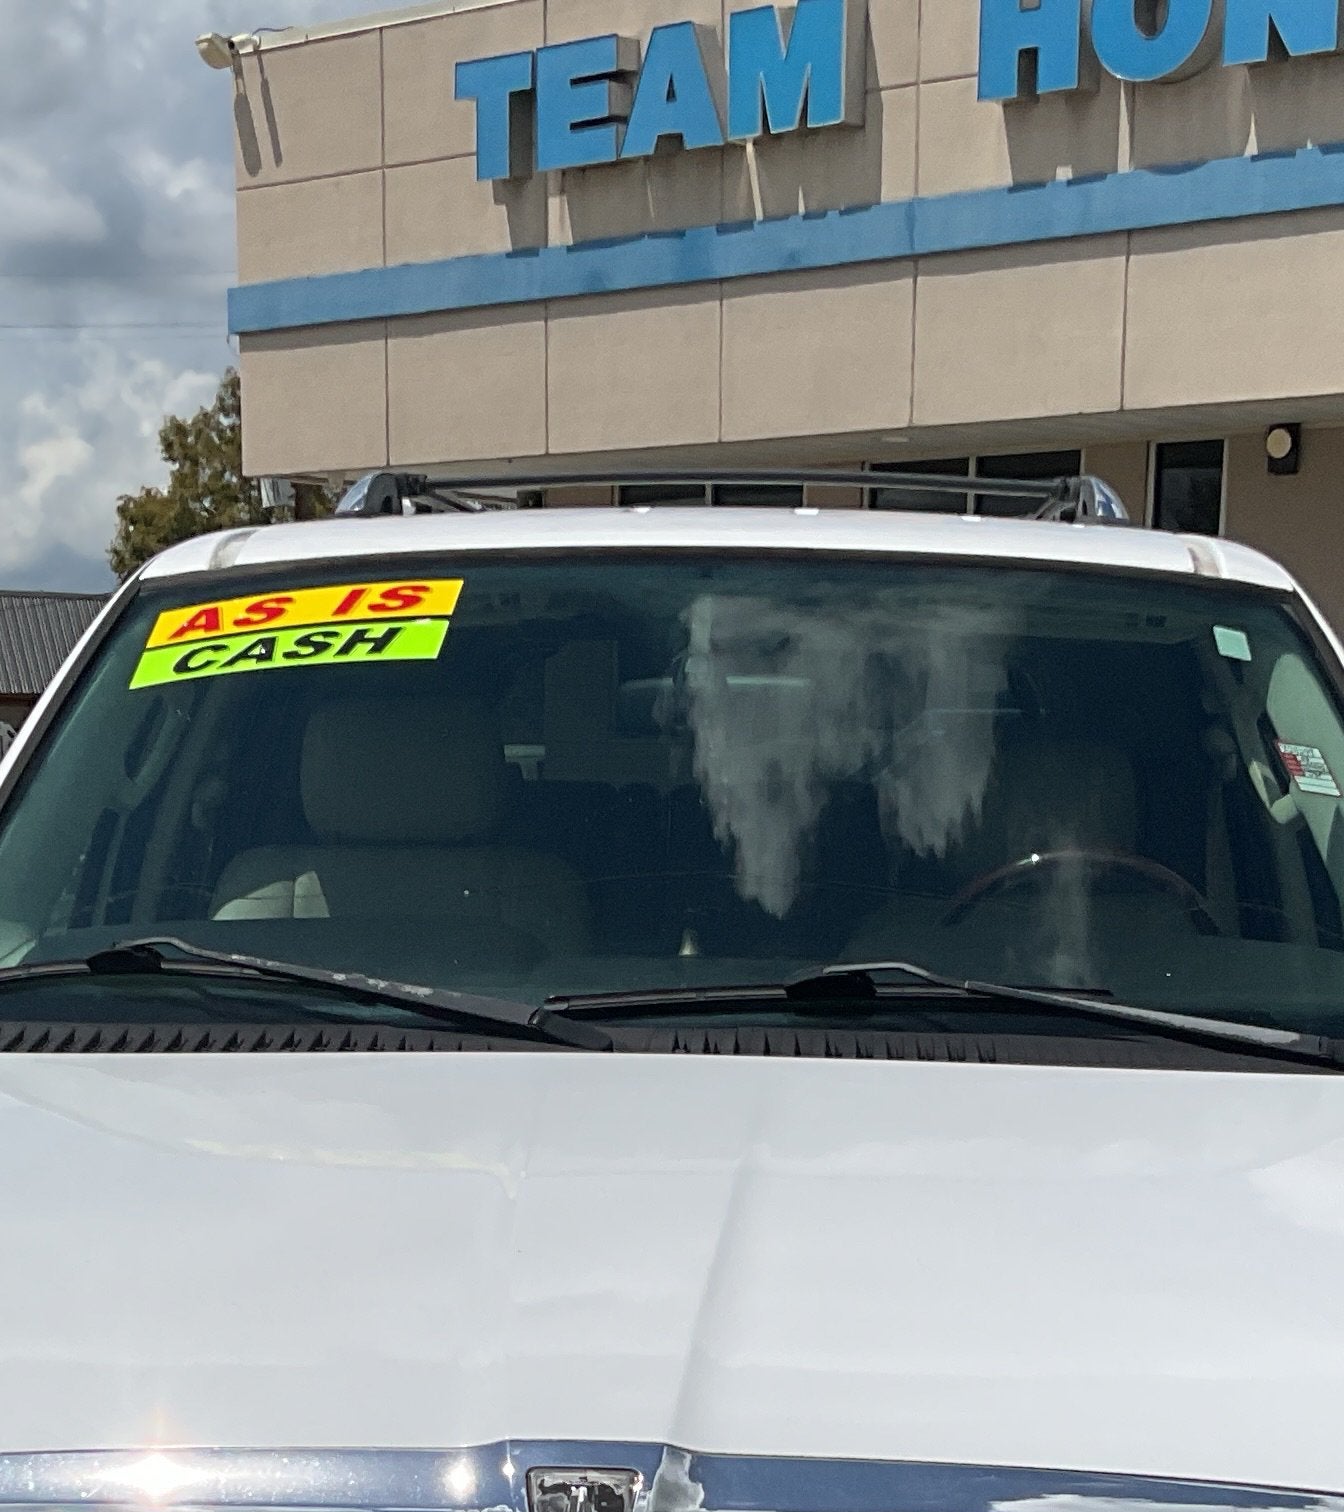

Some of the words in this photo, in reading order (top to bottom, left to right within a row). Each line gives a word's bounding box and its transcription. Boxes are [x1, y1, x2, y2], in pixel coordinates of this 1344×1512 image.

[455, 0, 847, 181] TEAM
[169, 596, 295, 639] AS
[331, 585, 431, 617] IS
[172, 626, 404, 674] CASH
